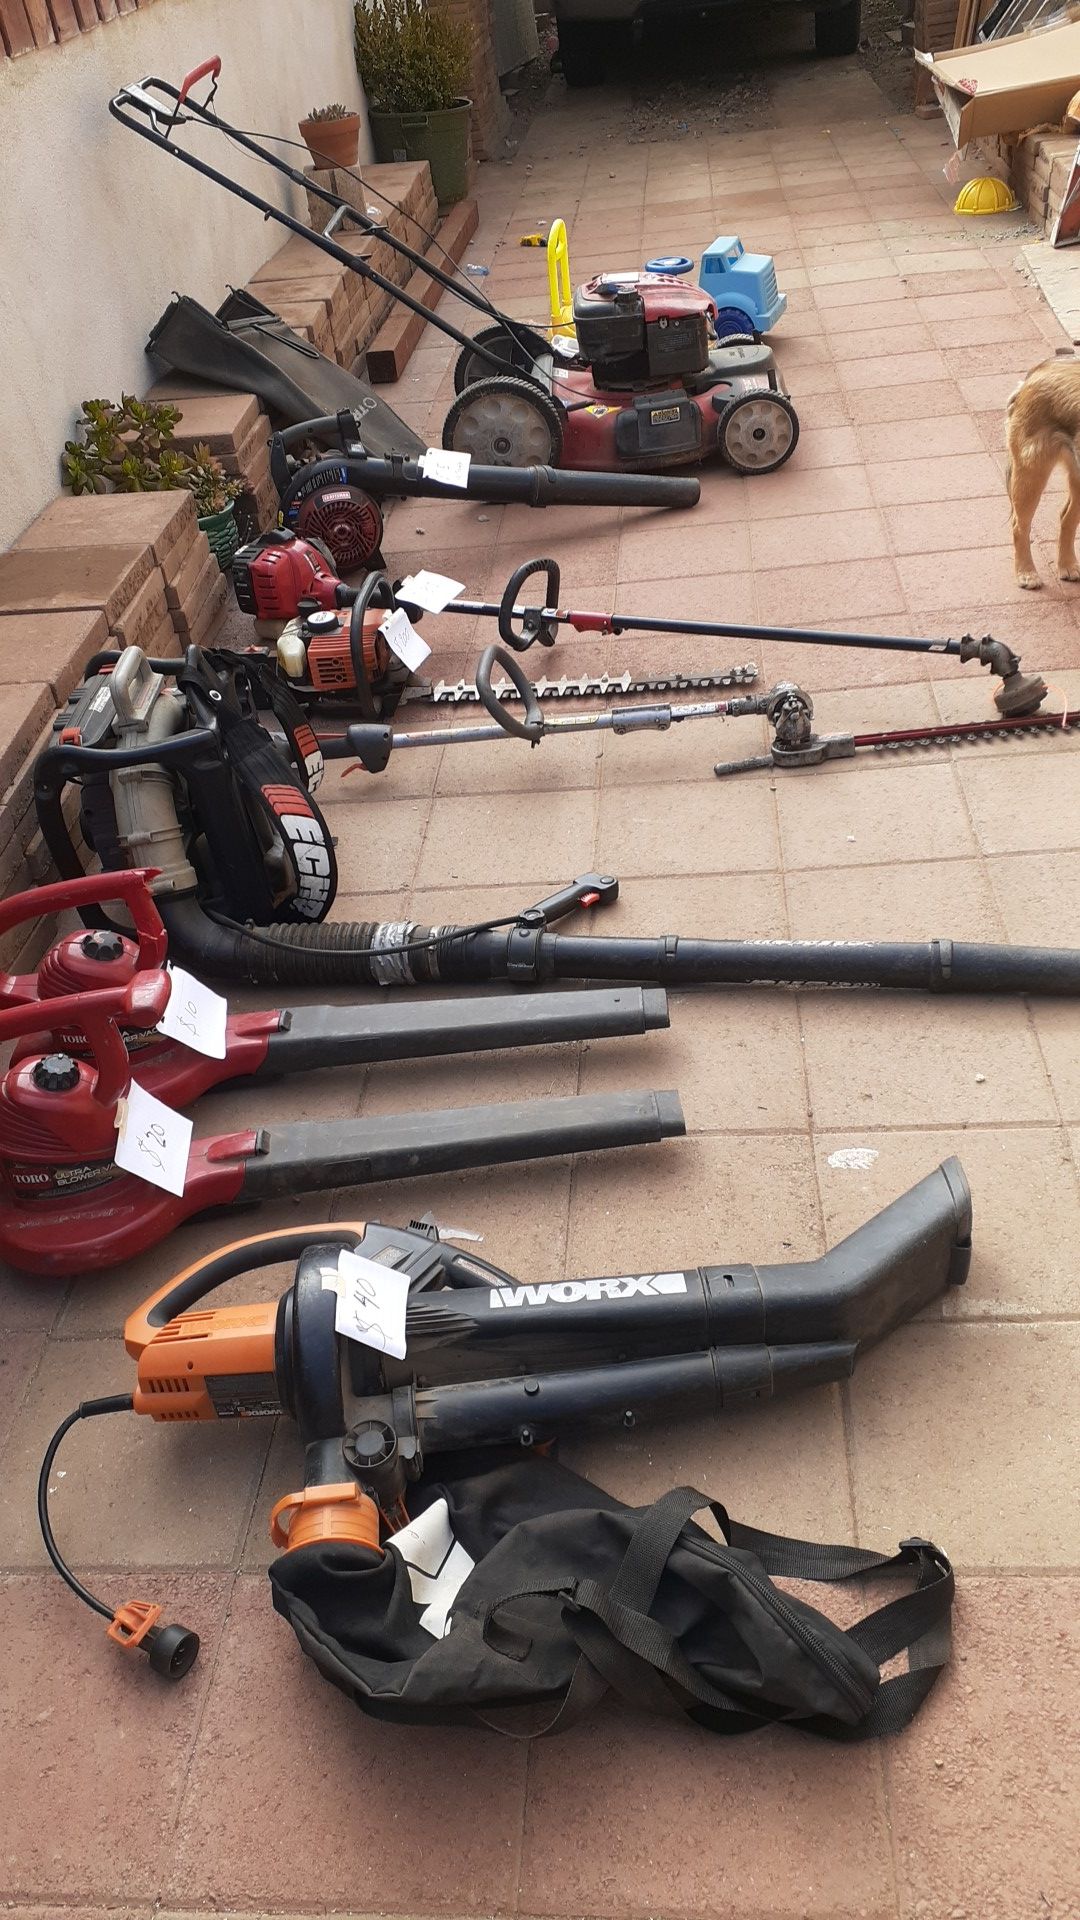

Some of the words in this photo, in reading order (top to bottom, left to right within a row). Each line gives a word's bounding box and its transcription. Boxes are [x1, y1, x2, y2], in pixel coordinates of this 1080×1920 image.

[176, 1000, 201, 1038] $10
[135, 1123, 167, 1172] $20
[13, 1174, 50, 1184] TORO
[55, 1166, 92, 1179] ULTRA
[57, 1169, 101, 1186] BLOWER
[489, 1273, 660, 1309] WORX
